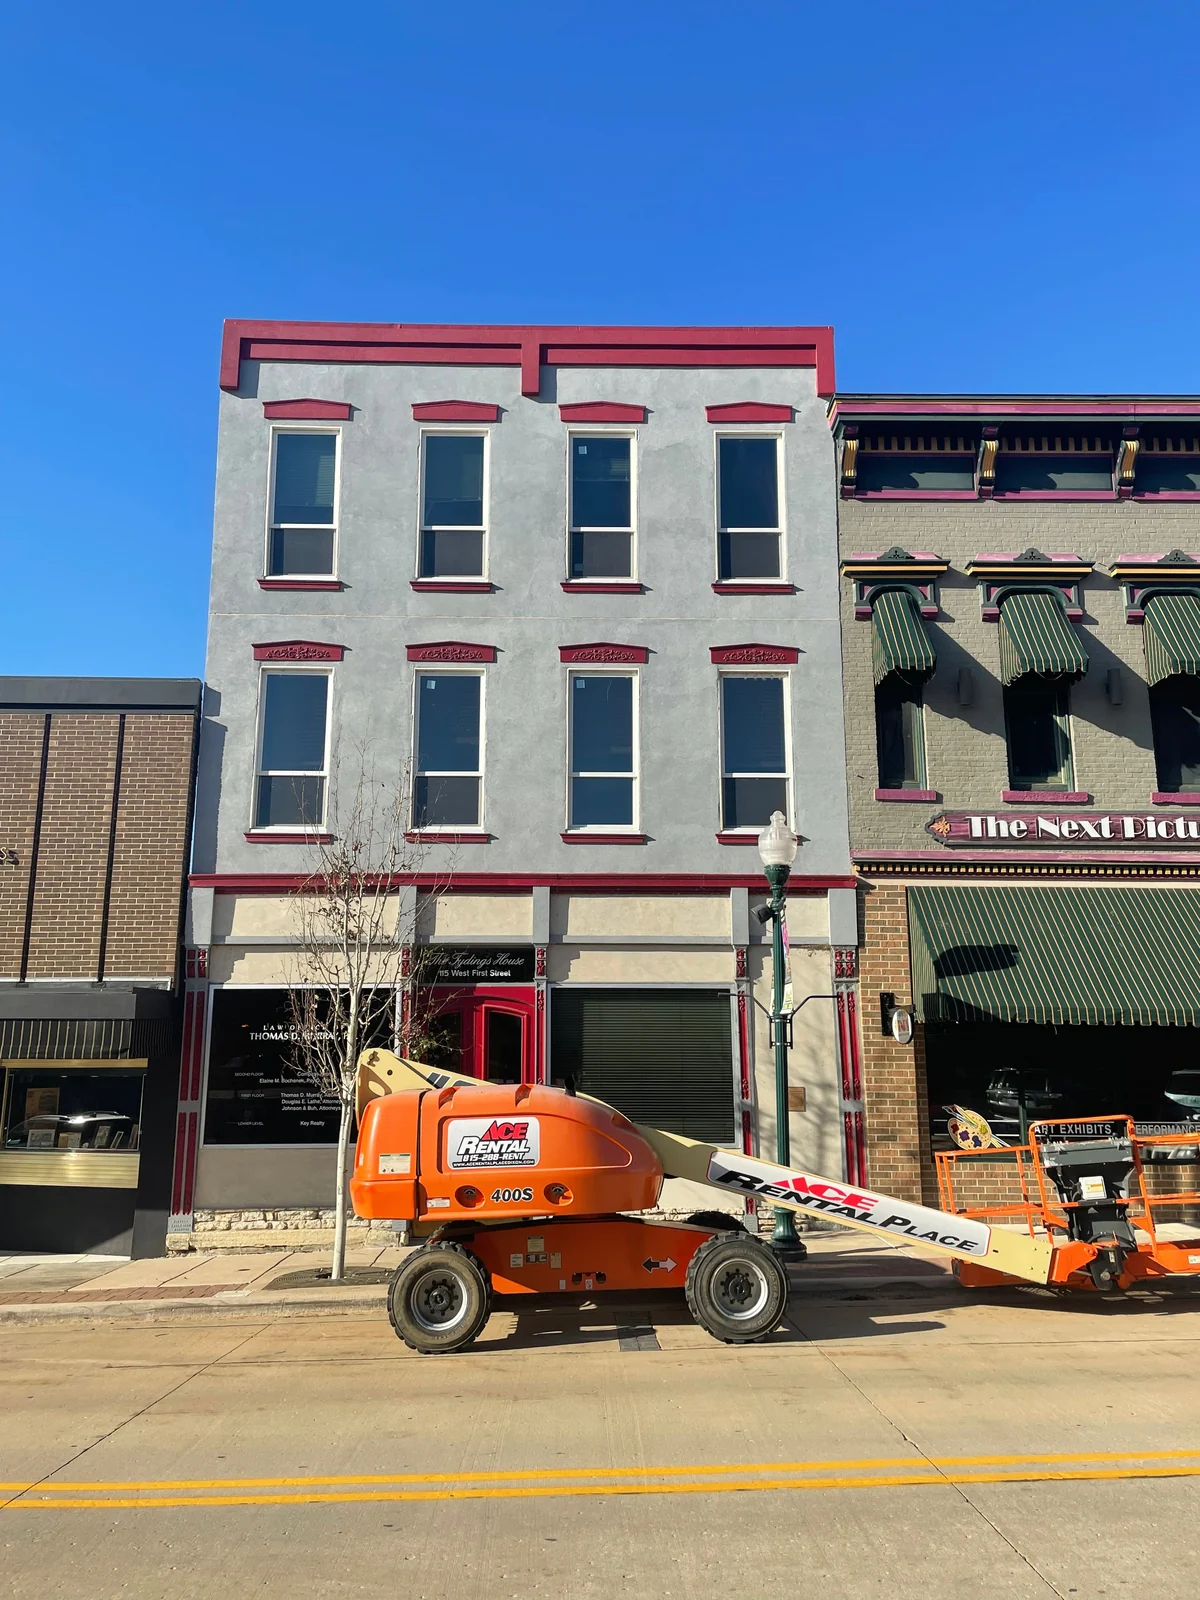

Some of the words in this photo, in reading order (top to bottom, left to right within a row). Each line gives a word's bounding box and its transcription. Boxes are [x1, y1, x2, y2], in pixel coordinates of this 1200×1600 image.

[966, 816, 1028, 838] The
[1037, 815, 1115, 838] Next
[428, 952, 449, 966] The
[492, 952, 525, 966] House
[451, 969, 470, 977] West
[471, 969, 489, 977] First
[489, 969, 512, 977] Street
[249, 1032, 289, 1041] THOMAS
[291, 1032, 301, 1041] D.
[481, 1120, 529, 1140] ACE
[1059, 1124, 1112, 1135] EXHIBITS
[1134, 1124, 1200, 1135] ERFORMANCE
[457, 1135, 531, 1155] RENTAL
[490, 1186, 534, 1204] 400S
[771, 1176, 879, 1212] ACE
[716, 1170, 885, 1226] RENTAL
[879, 1214, 980, 1252] PLACE
